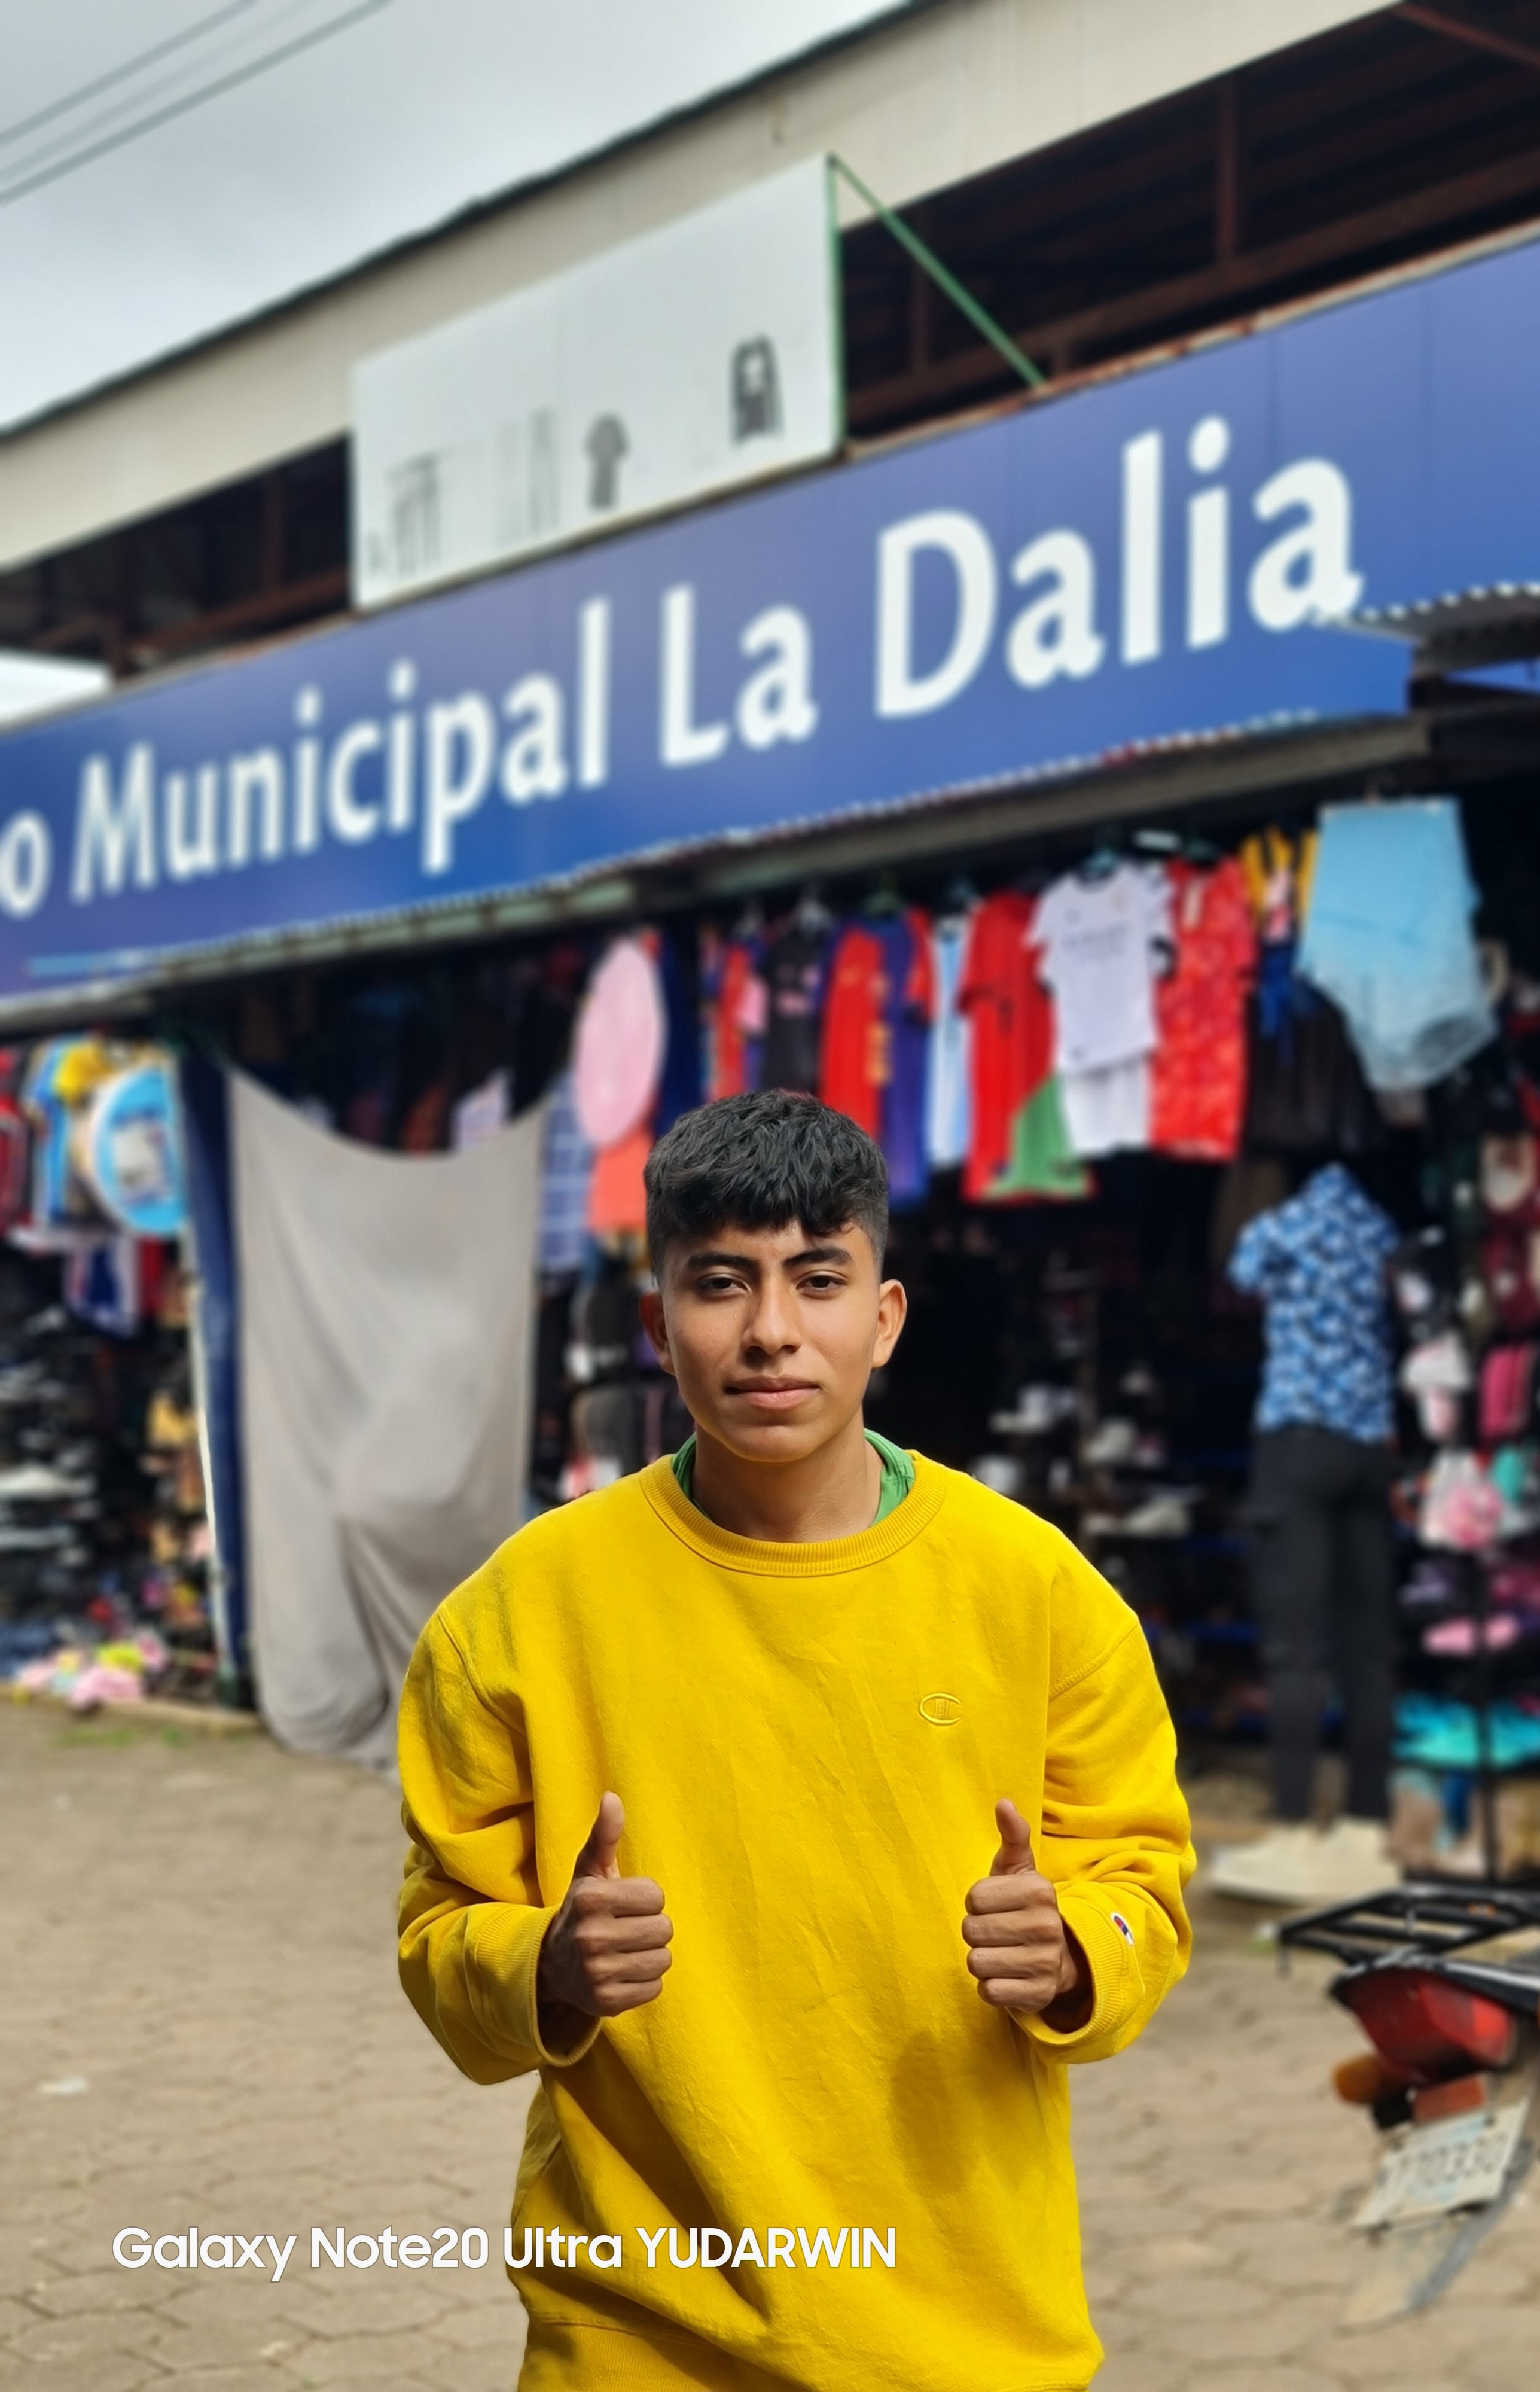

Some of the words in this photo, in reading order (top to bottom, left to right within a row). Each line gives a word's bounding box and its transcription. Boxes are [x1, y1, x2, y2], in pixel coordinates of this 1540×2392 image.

[0, 812, 51, 918] o
[72, 597, 609, 903] Municipal
[659, 583, 819, 769] La
[874, 414, 1364, 720] Dalia
